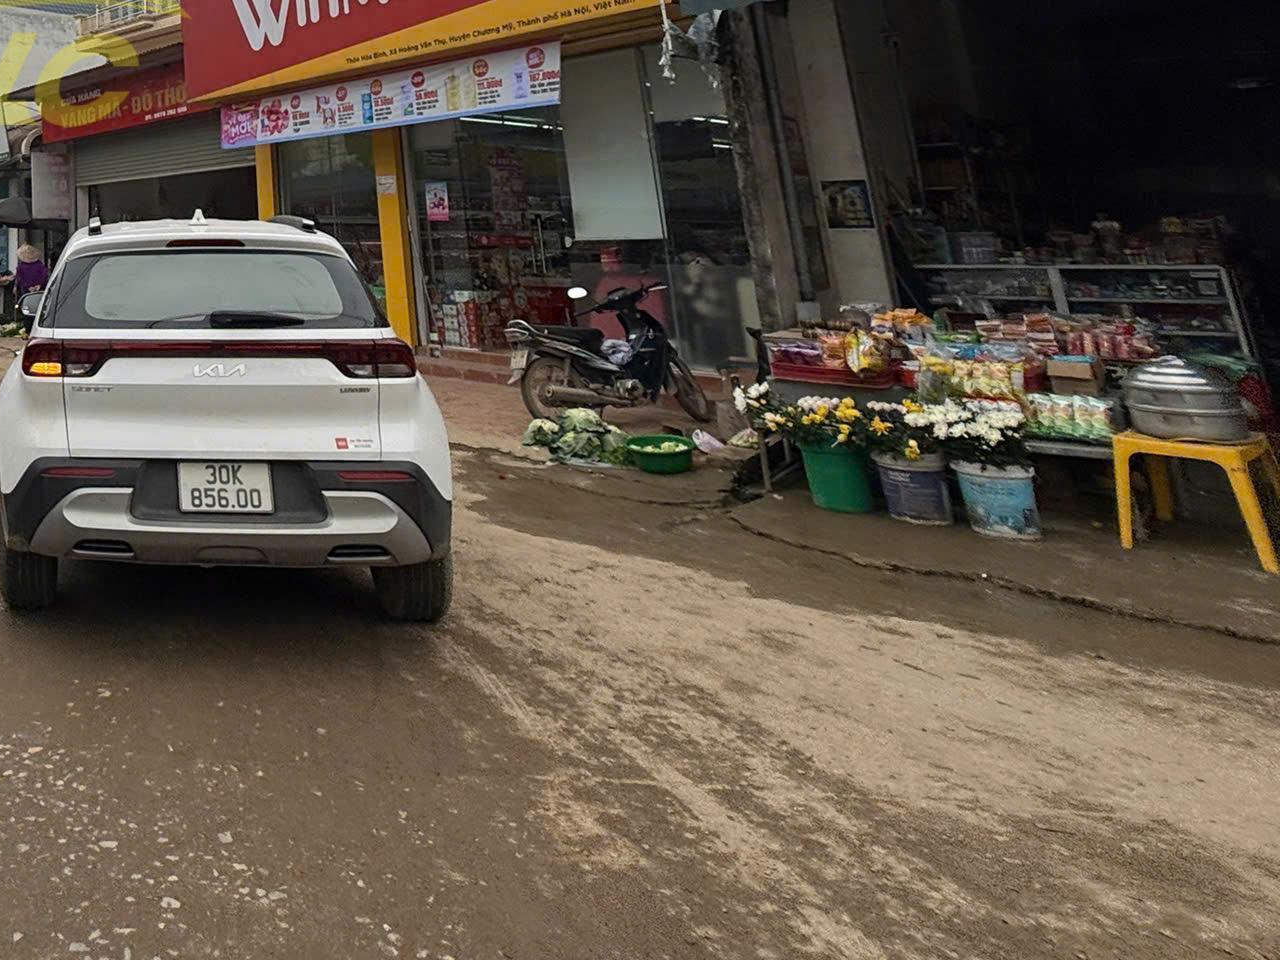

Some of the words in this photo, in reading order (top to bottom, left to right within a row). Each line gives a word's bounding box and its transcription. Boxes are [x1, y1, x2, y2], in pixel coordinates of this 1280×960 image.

[517, 17, 541, 28] Thành
[543, 11, 559, 23] phố
[193, 364, 247, 378] KIA
[205, 464, 243, 485] 30K
[191, 487, 262, 509] 856.00
